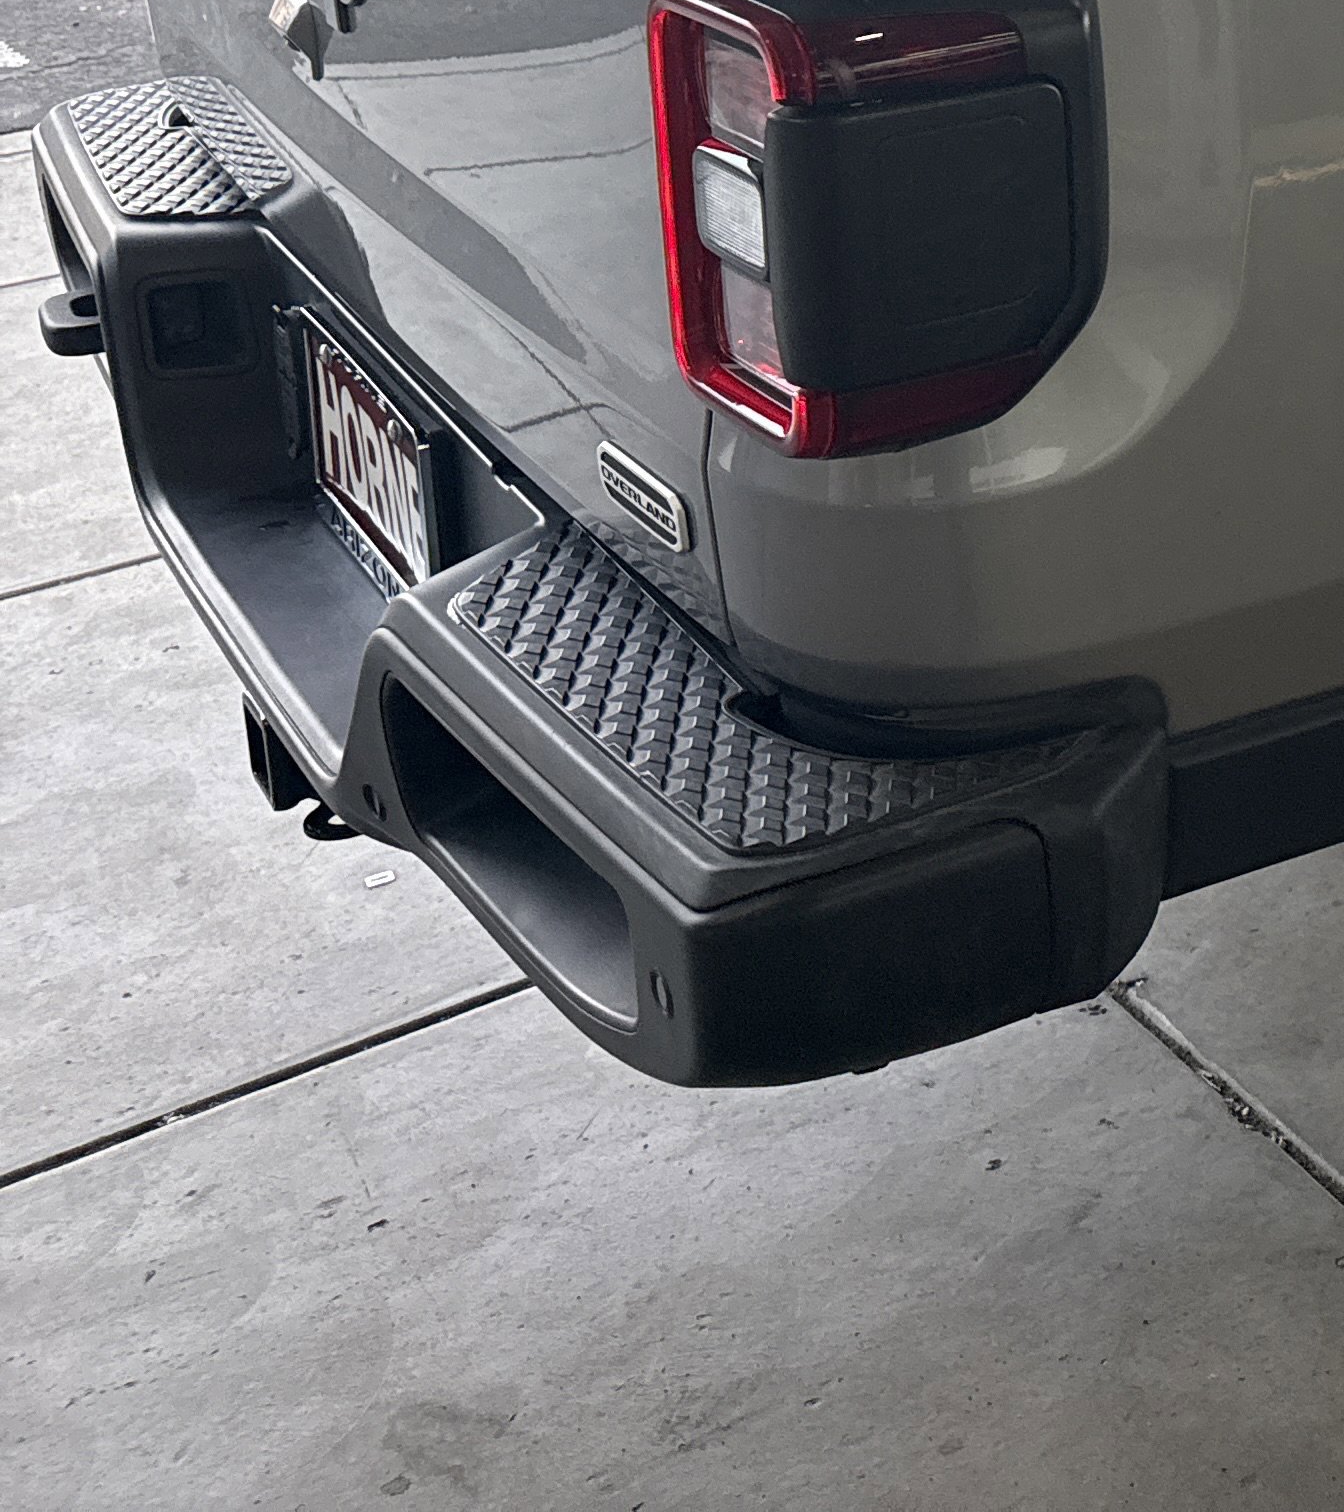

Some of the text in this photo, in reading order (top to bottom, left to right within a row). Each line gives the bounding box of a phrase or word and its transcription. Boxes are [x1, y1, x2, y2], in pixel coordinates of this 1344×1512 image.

[316, 356, 427, 585] HORNE
[601, 465, 677, 533] OVERLAND
[330, 504, 402, 598] ARIZON
